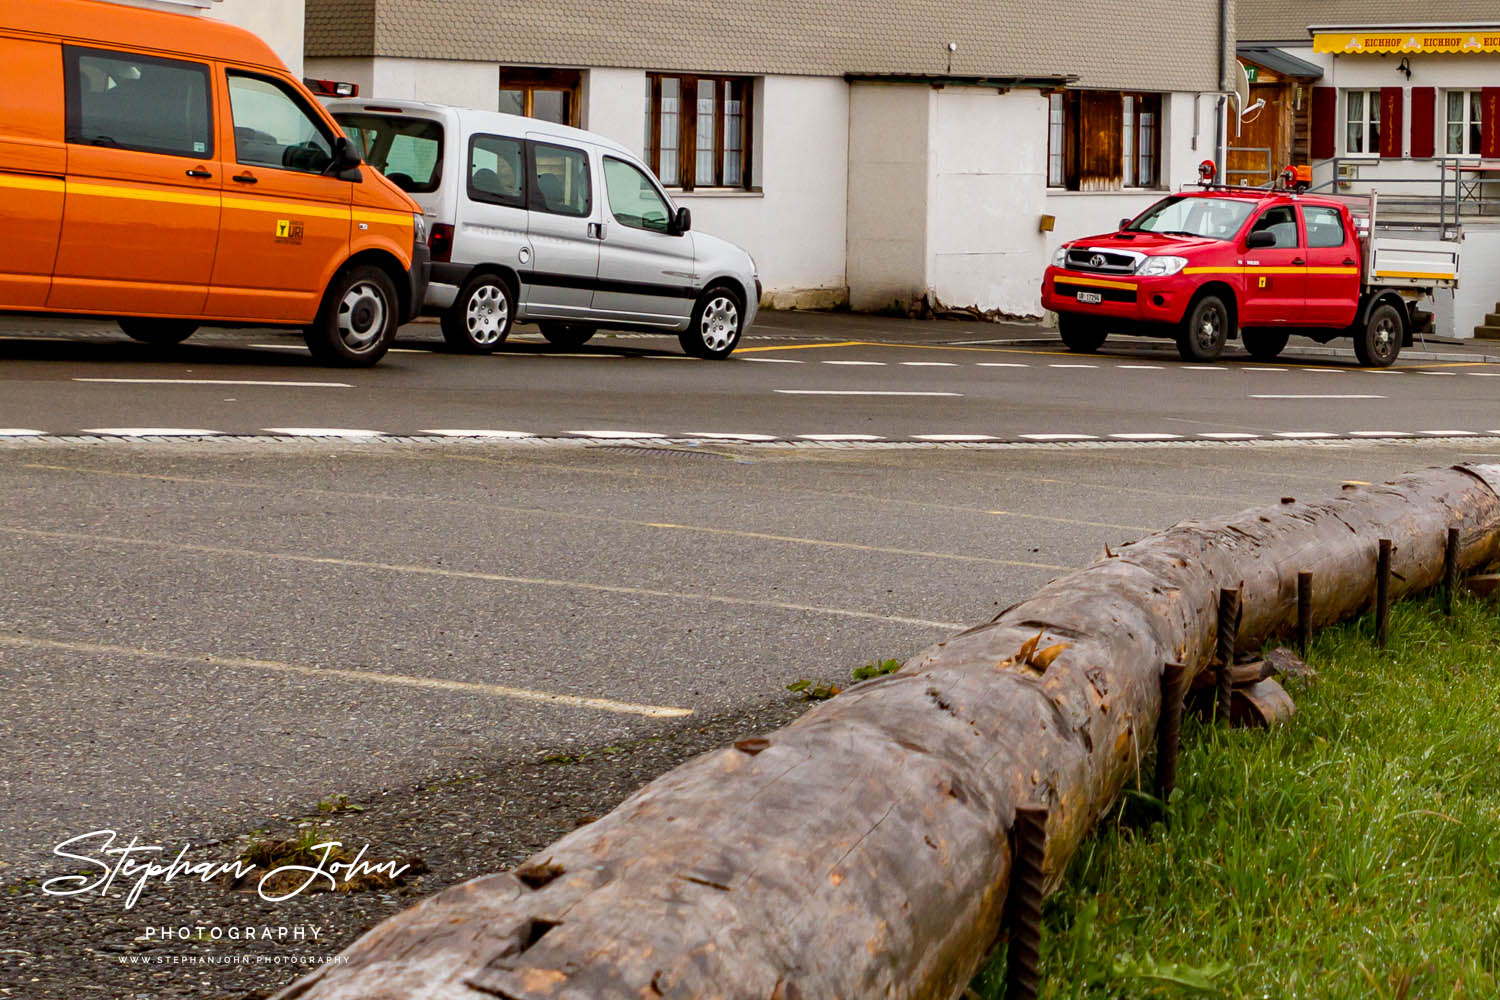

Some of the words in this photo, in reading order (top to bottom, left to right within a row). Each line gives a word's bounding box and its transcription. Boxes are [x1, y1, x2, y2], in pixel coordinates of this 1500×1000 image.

[1364, 38, 1402, 47] EICHHOF
[1423, 38, 1462, 47] EICHHOF
[288, 225, 304, 239] URI
